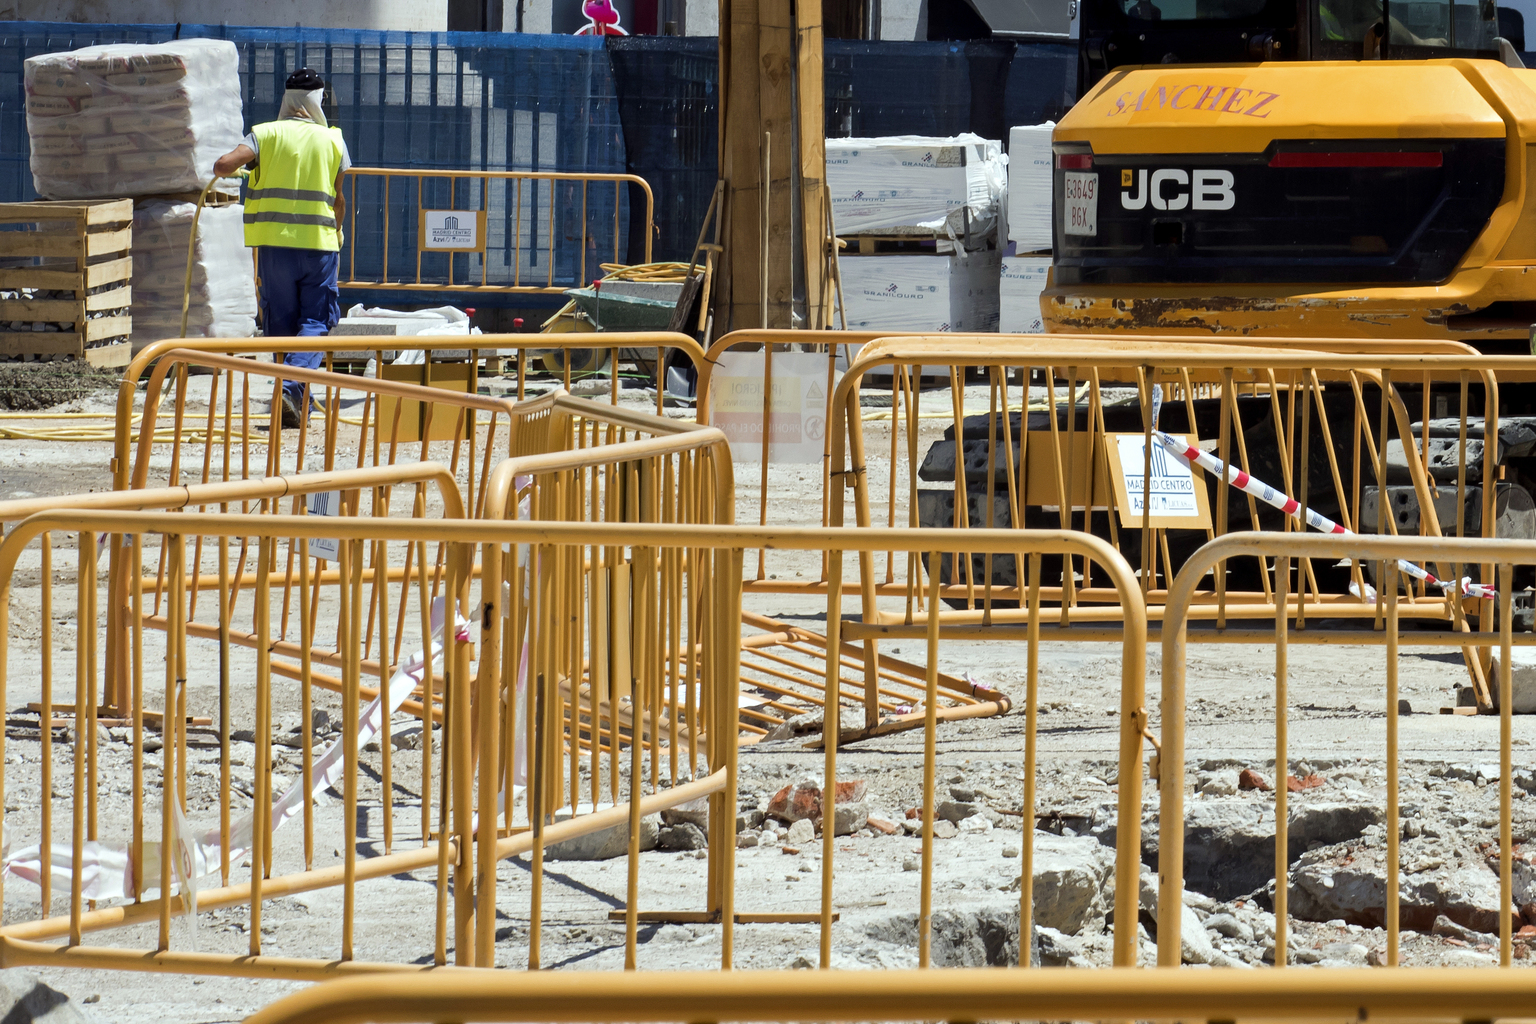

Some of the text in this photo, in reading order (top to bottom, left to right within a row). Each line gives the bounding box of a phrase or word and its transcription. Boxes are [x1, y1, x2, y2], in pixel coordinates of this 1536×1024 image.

[1106, 84, 1281, 119] SANCHEZ
[1121, 169, 1236, 211] JCB
[1071, 206, 1088, 227] BGX
[1127, 479, 1192, 491] MADID CENTRO
[1134, 497, 1151, 510] Az
